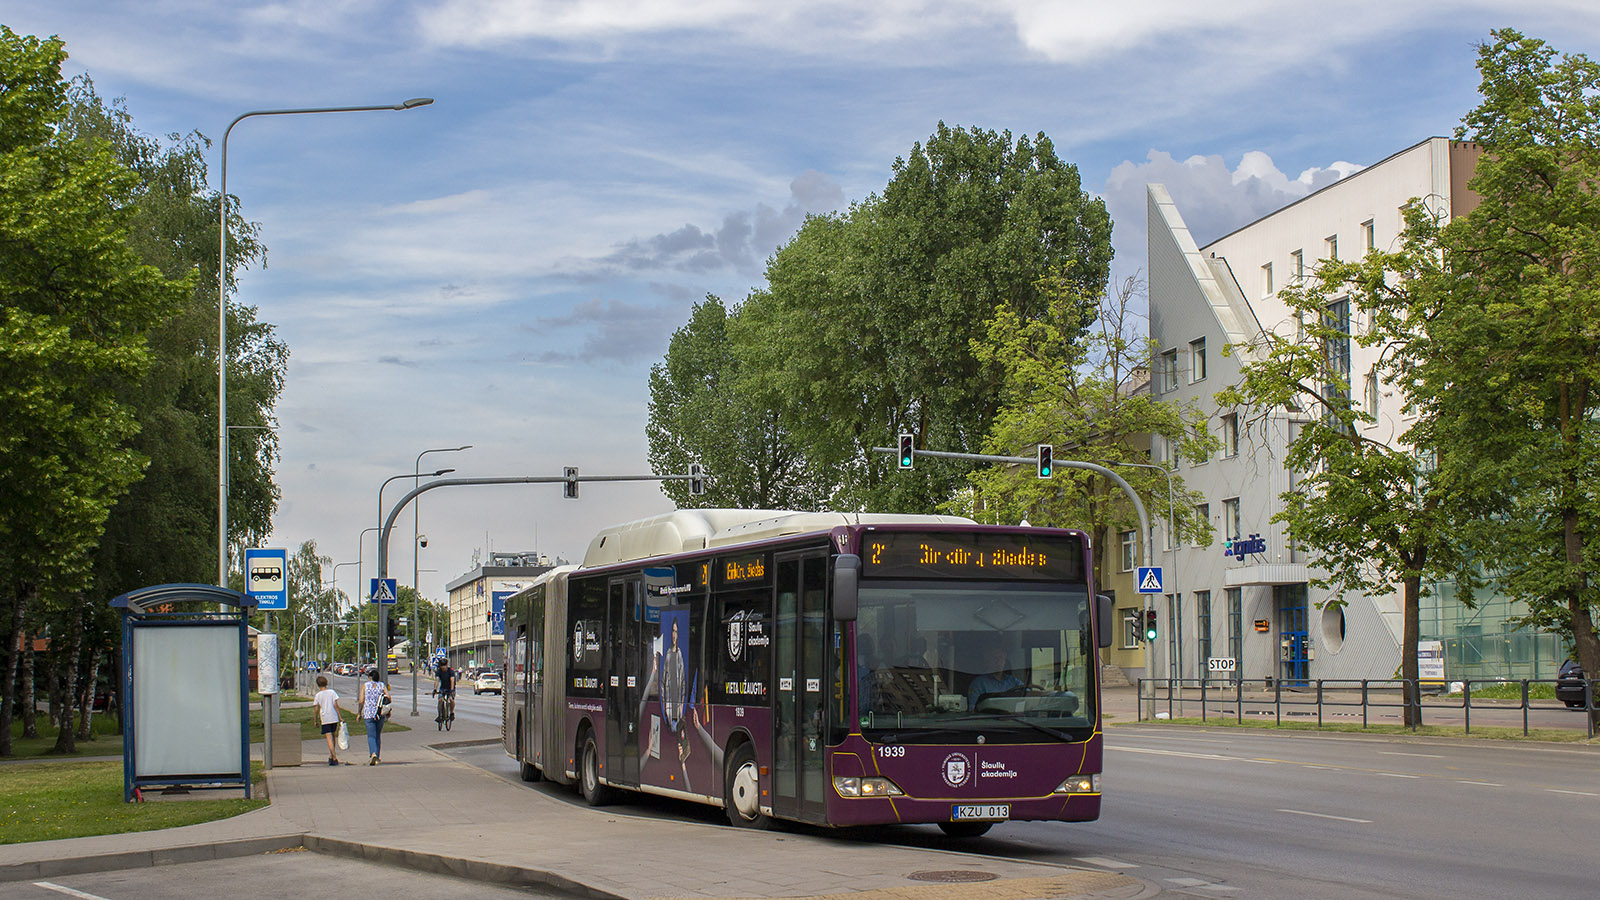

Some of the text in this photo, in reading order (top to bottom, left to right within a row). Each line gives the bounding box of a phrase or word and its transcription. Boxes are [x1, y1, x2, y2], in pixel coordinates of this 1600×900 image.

[1233, 534, 1266, 561] ignitis
[1209, 659, 1235, 669] STOP
[740, 679, 763, 695] UŽAUGTI
[878, 746, 905, 758] 1939
[981, 770, 1017, 779] akademija
[960, 807, 1008, 817] KZU 013
